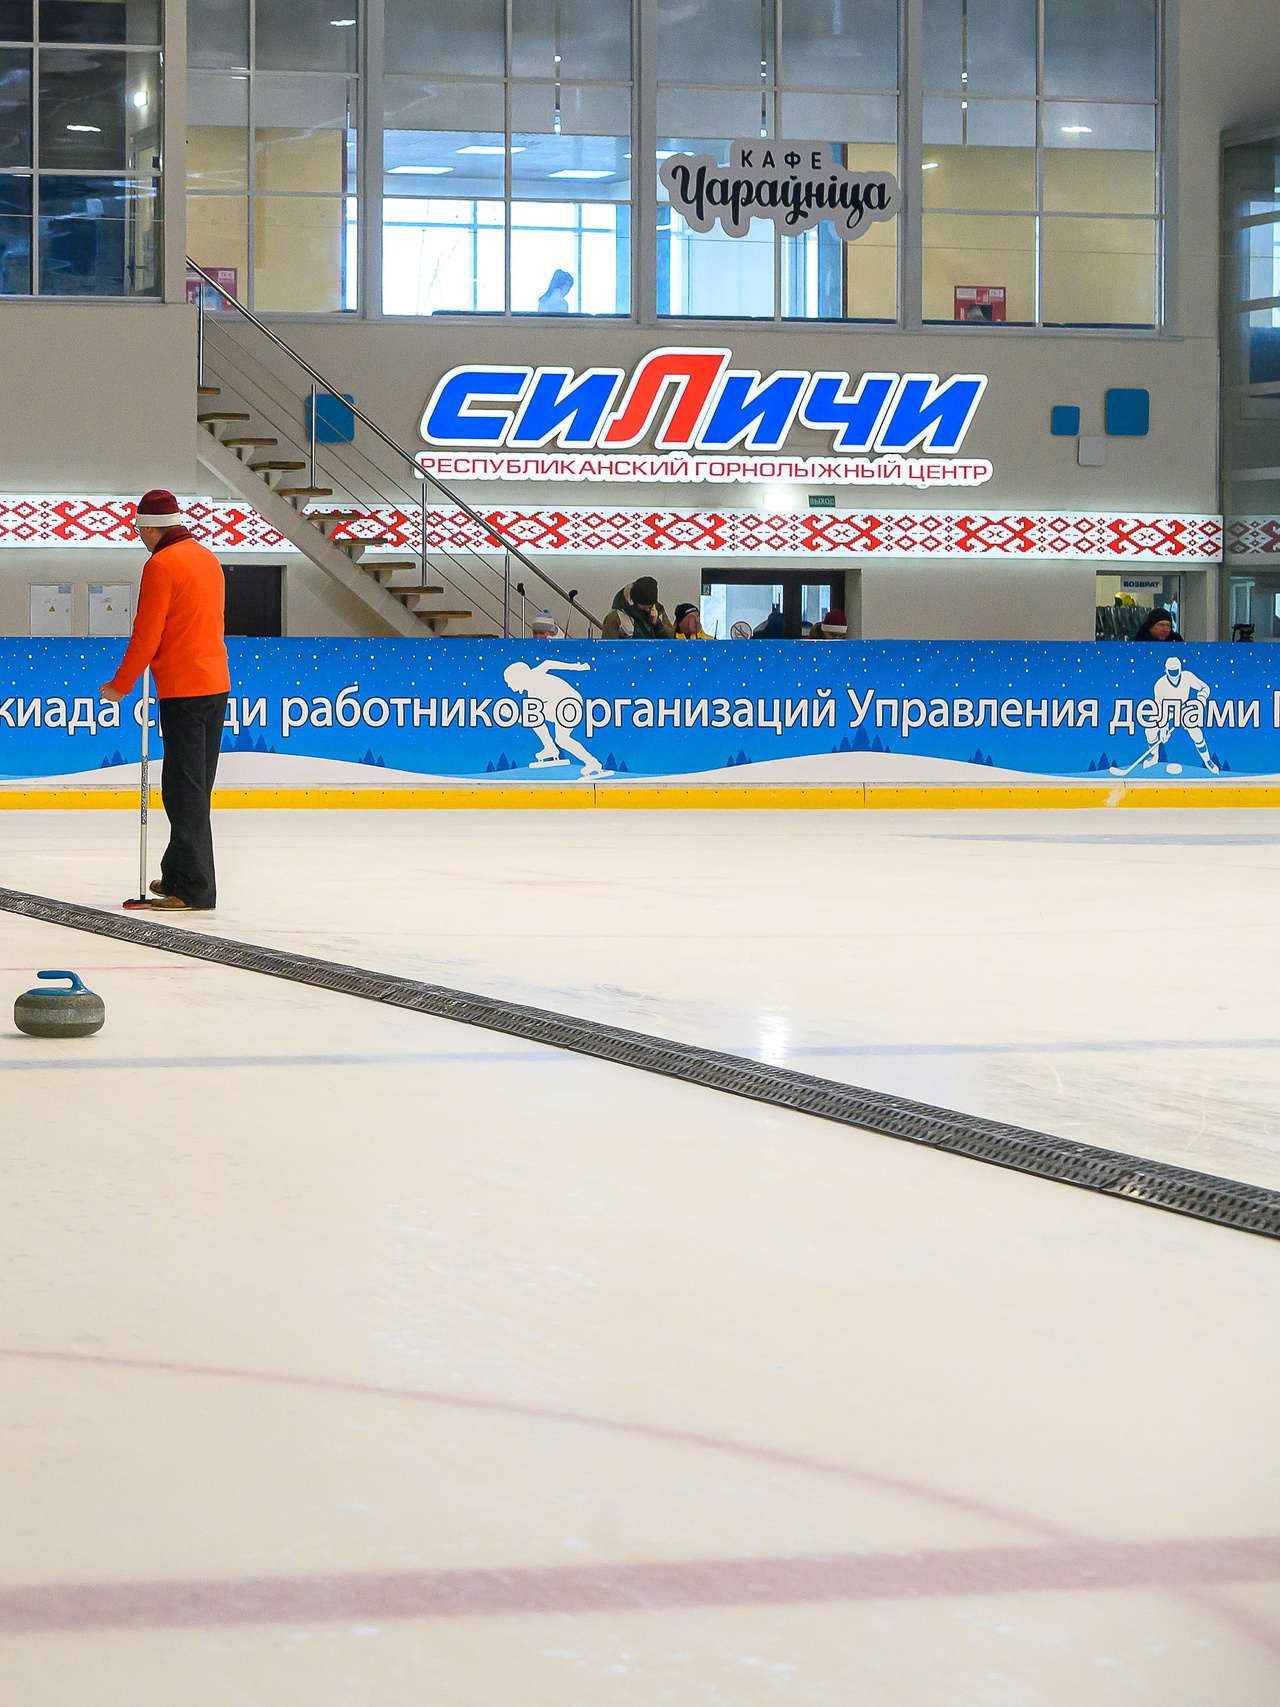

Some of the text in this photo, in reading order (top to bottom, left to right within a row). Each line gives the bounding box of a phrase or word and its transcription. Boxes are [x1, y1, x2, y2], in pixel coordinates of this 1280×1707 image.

[741, 149, 823, 170] КАФЕ
[671, 164, 892, 229] Чараўніца
[420, 452, 988, 484] РЕСПУБЛИКАНСКИЙ ГОРНОЛЫЖНЫЙ ЦЕНТР
[810, 497, 835, 505] ВЫХОД
[281, 686, 545, 738] работников
[555, 688, 836, 736] организаций
[848, 691, 1097, 737] Управления
[1109, 699, 1261, 736] делами
